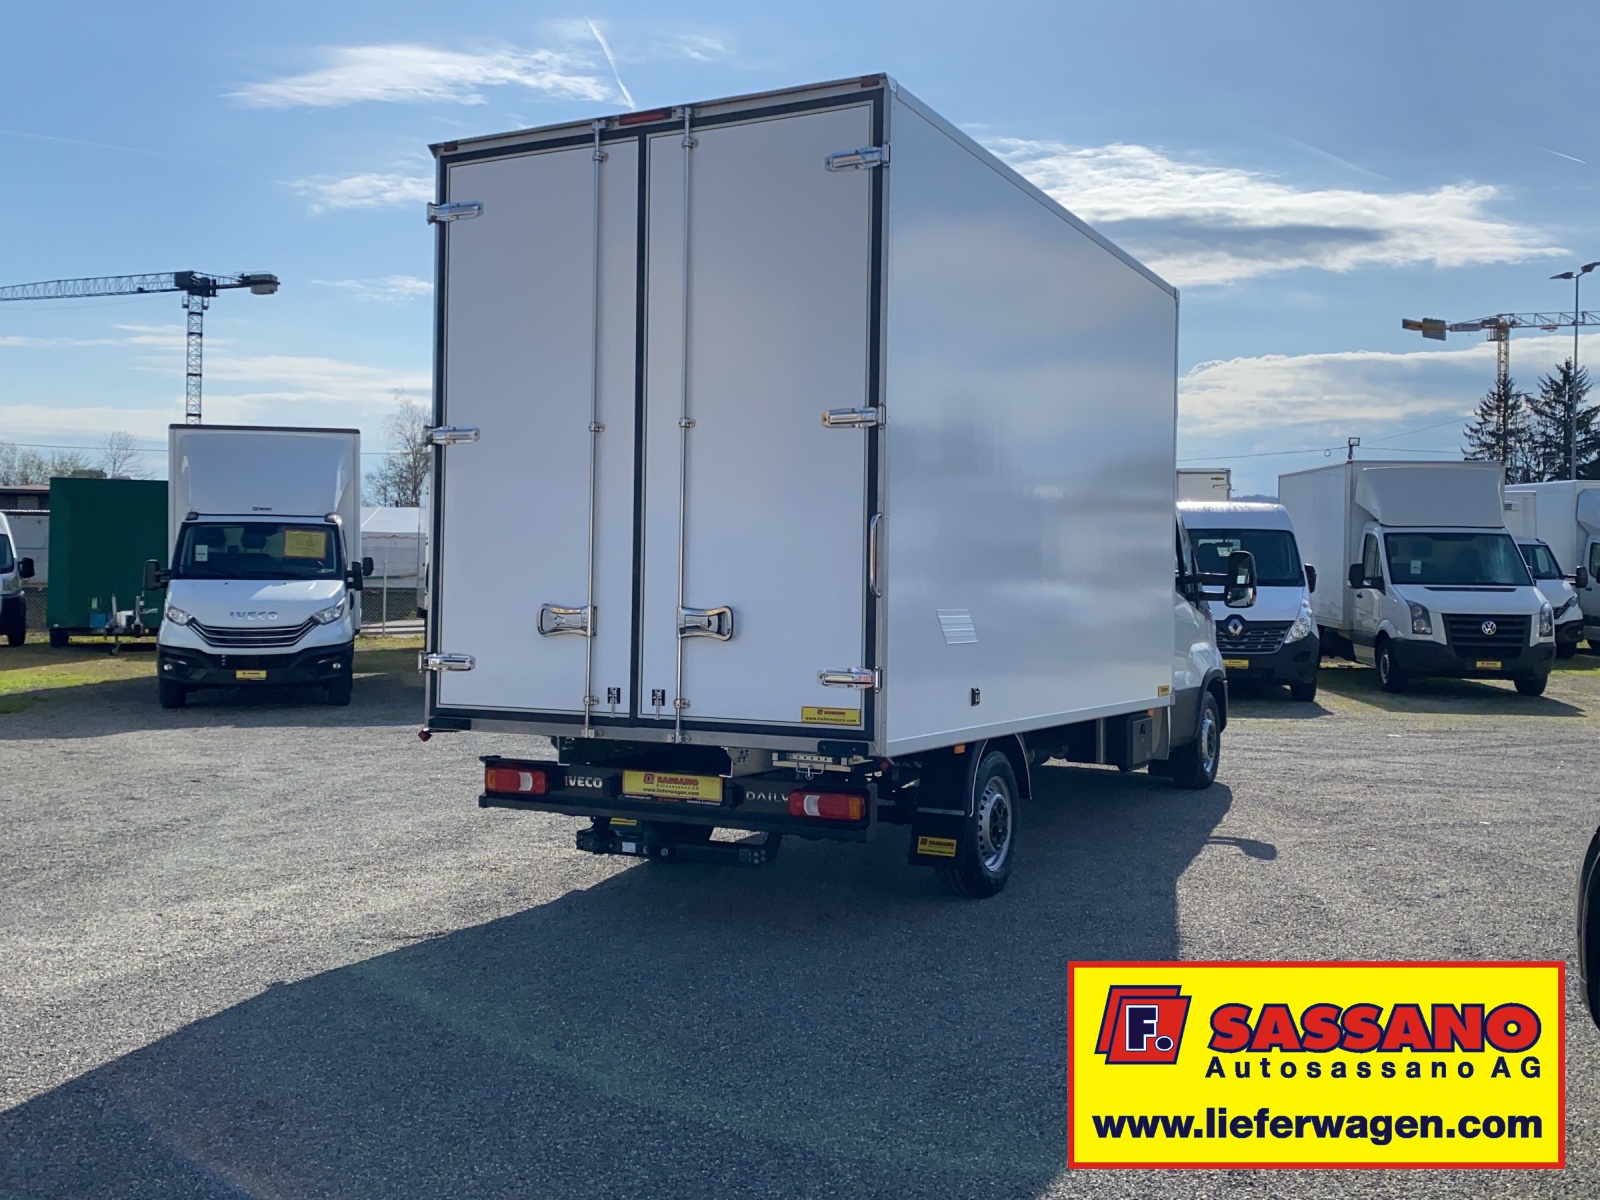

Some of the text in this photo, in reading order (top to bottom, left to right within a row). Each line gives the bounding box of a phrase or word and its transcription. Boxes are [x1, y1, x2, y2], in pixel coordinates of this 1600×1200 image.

[229, 611, 279, 621] IVECO
[564, 775, 603, 788] IVECO
[656, 776, 699, 786] SASSANO
[643, 787, 700, 796] www.lieferwagen.com
